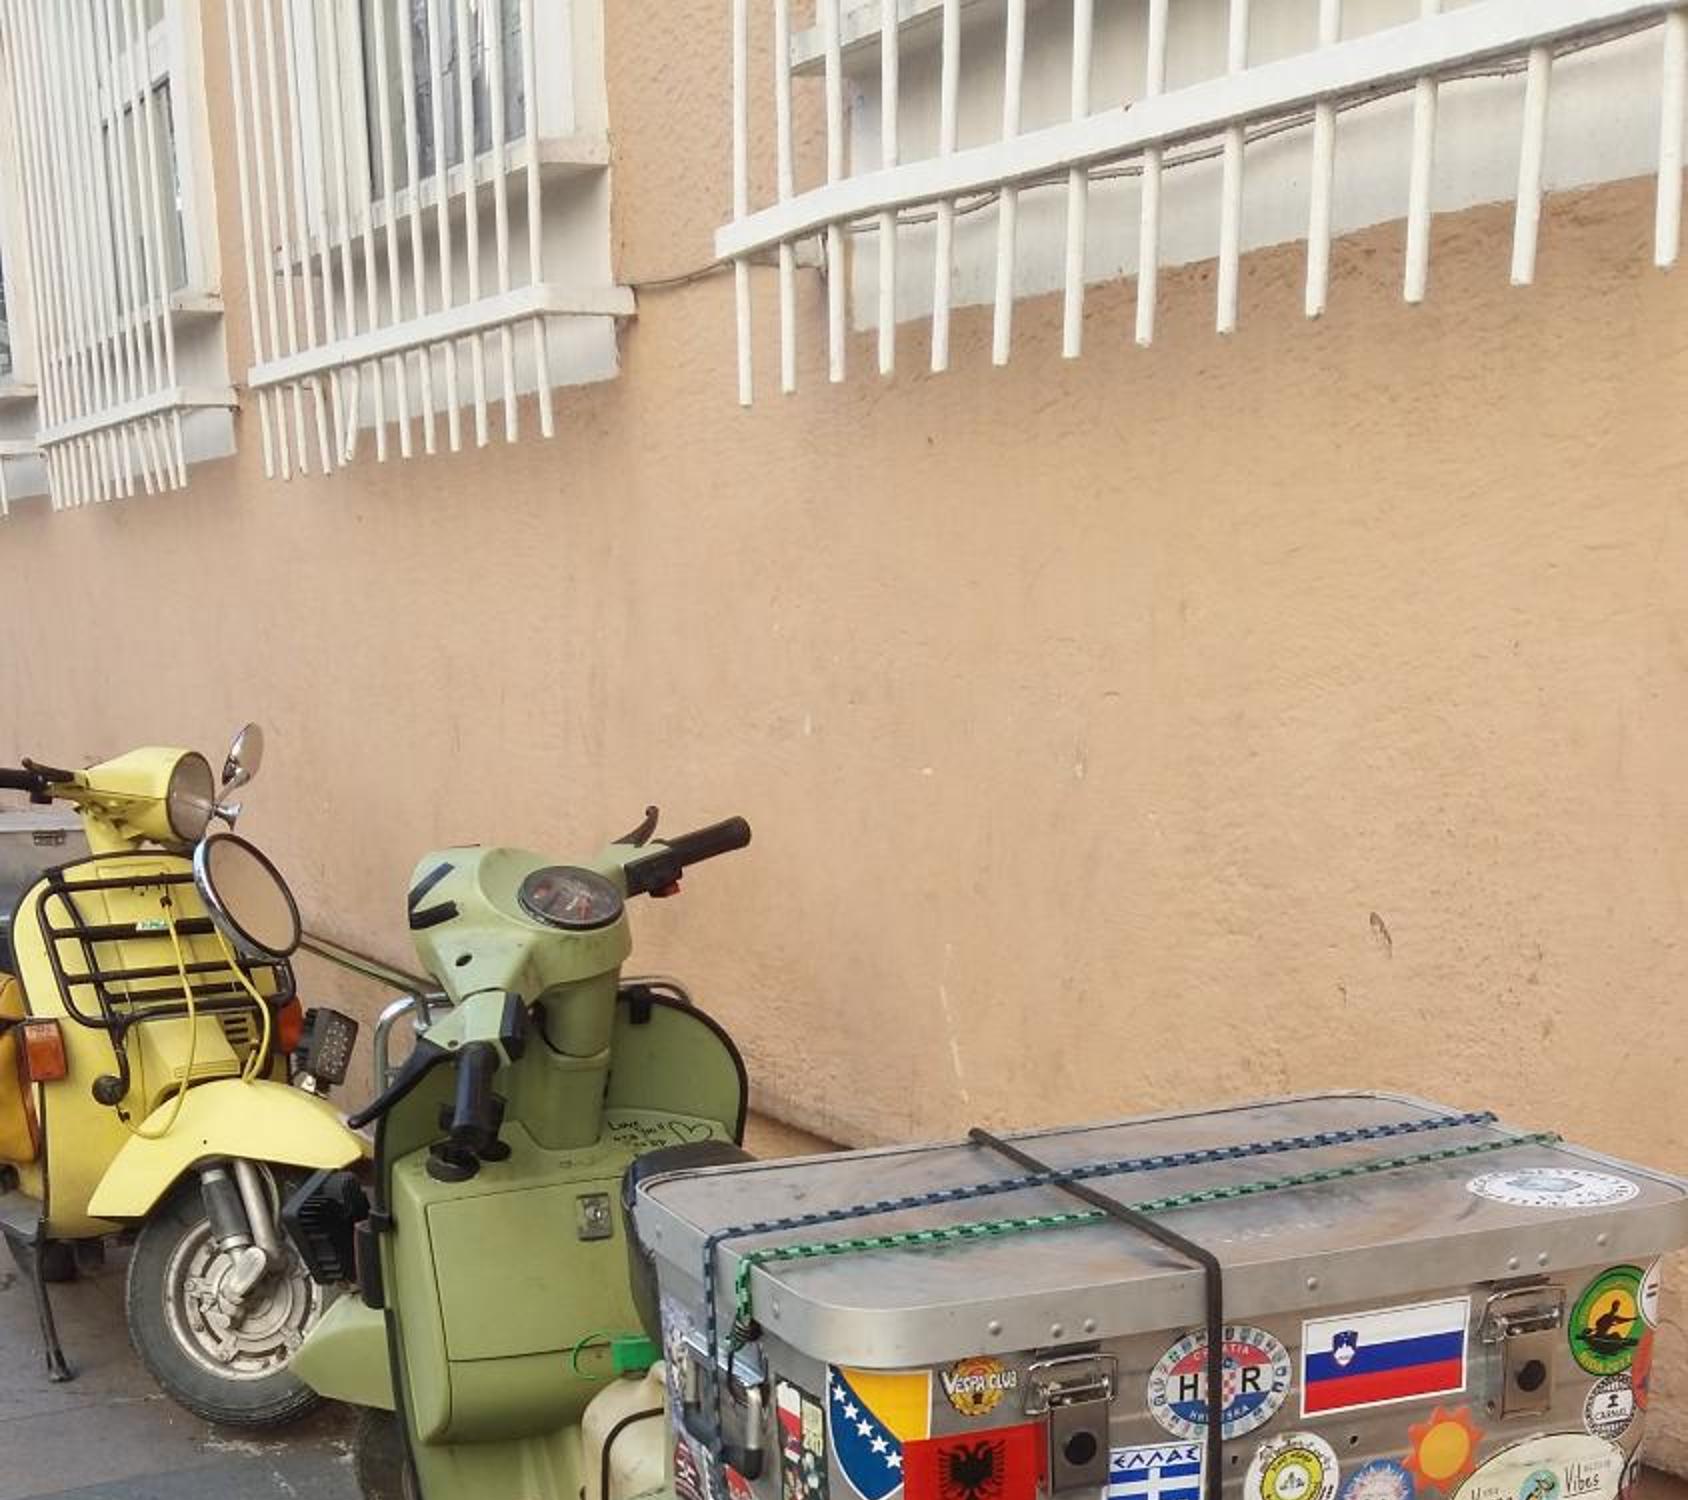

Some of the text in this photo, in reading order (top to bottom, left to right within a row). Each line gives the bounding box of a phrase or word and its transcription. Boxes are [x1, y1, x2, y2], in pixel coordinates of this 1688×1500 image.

[941, 1369, 1018, 1395] VESPA CLUB
[1179, 1366, 1261, 1401] H R
[1562, 1461, 1601, 1494] Vibes
